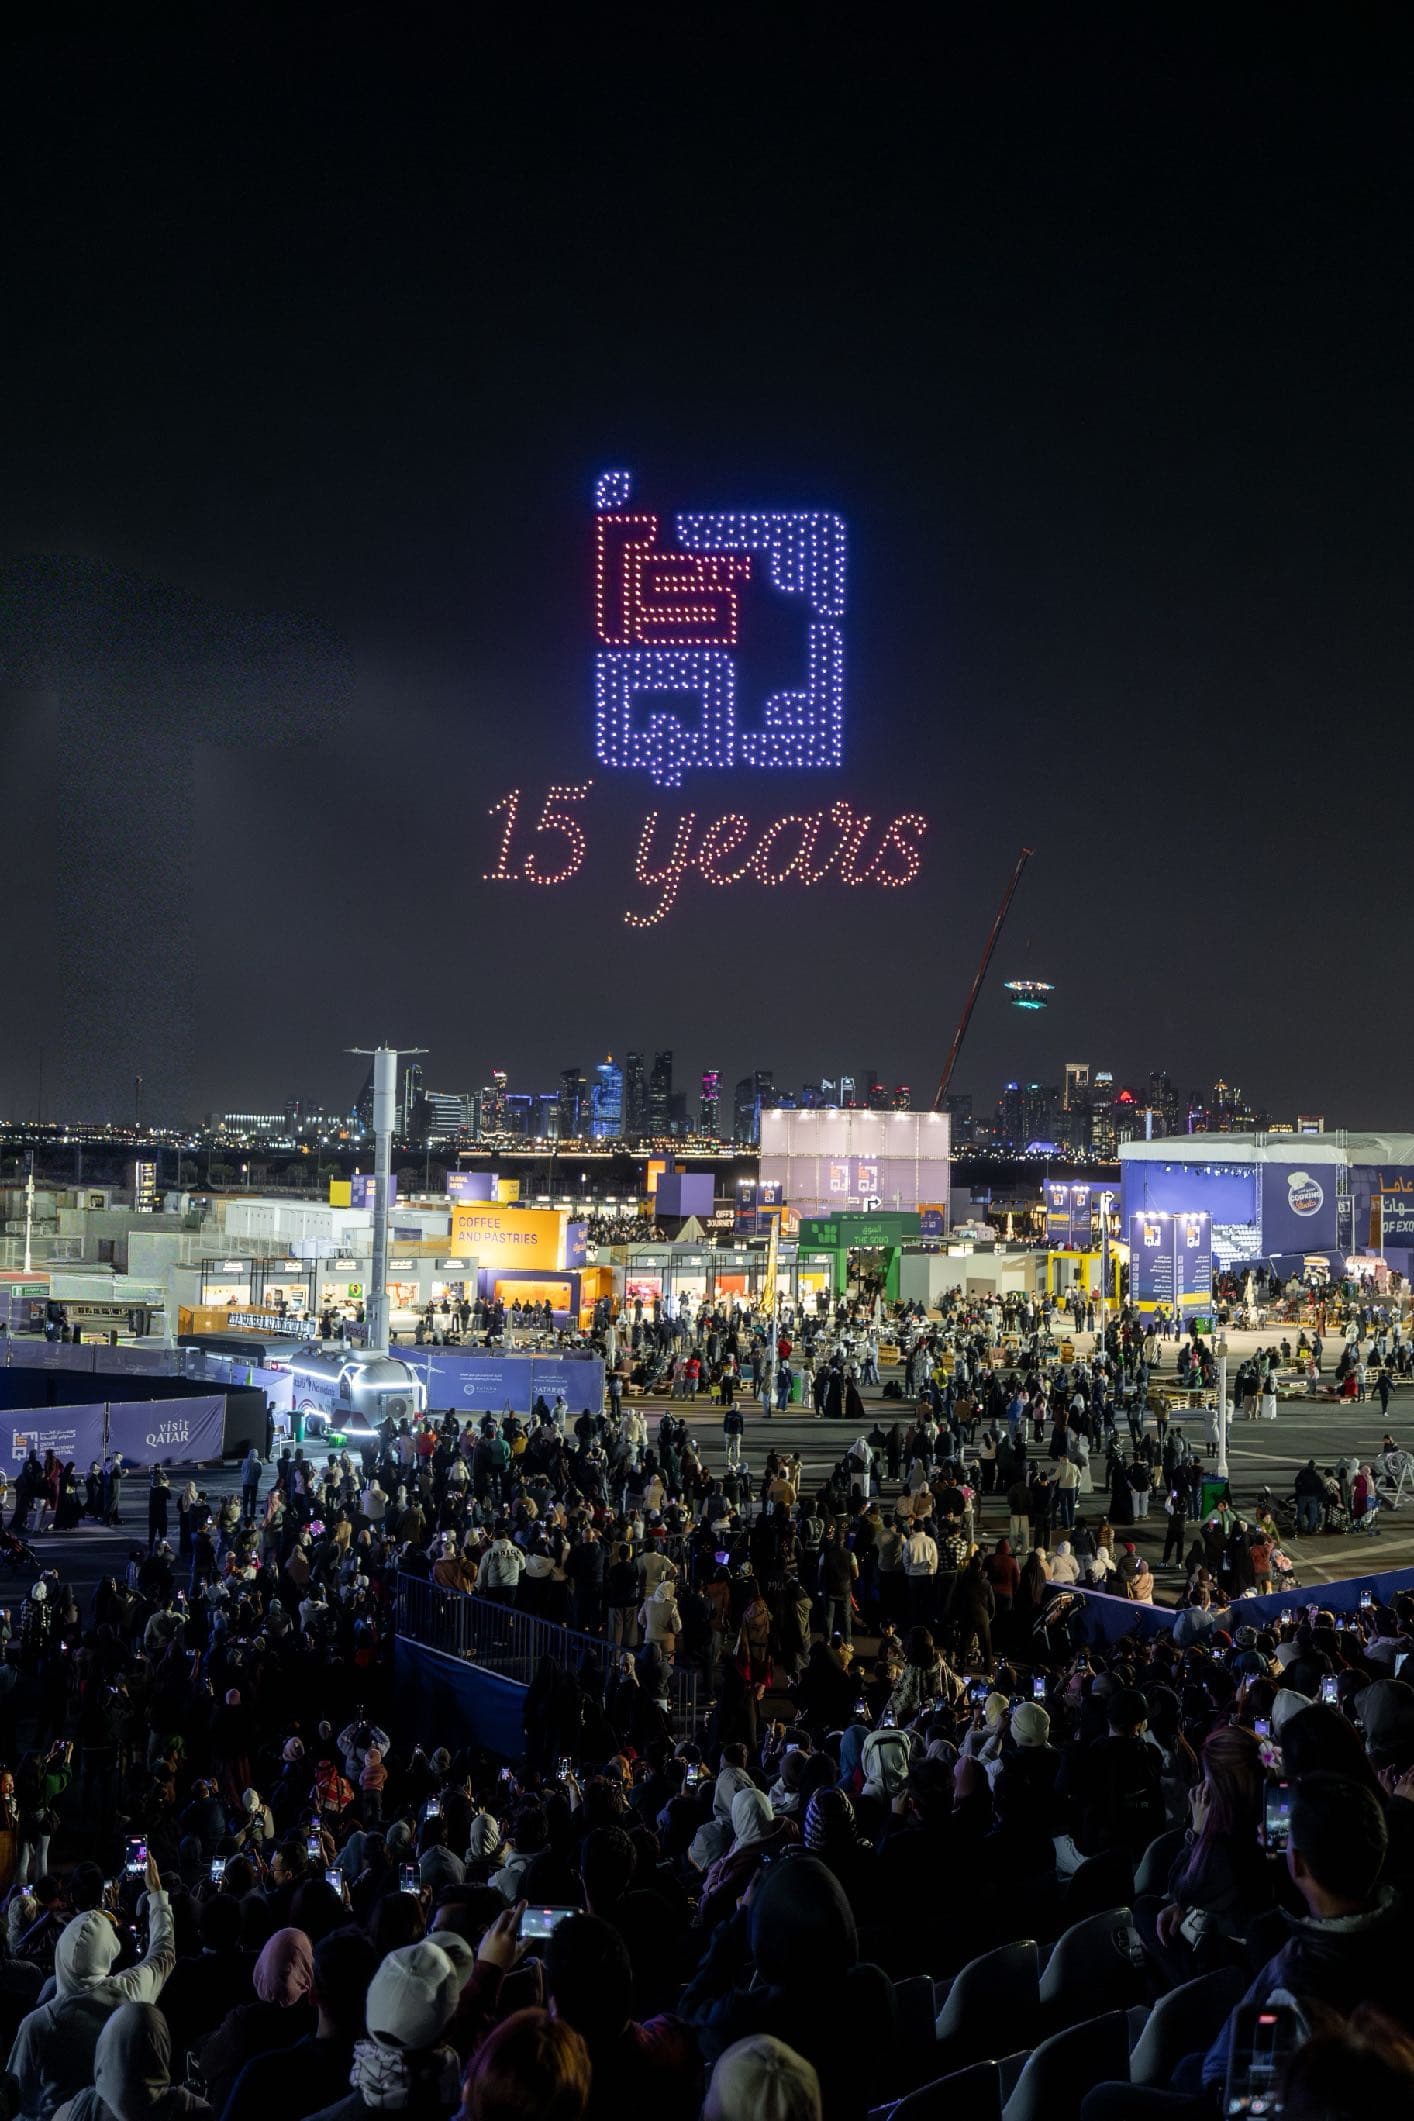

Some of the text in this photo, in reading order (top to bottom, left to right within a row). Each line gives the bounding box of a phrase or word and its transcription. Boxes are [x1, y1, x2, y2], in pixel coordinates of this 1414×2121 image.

[482, 779, 928, 928] 15 years
[458, 1216, 501, 1229] COFFEE
[458, 1231, 538, 1245] AND PASTRIES
[159, 1418, 189, 1433] visit
[146, 1431, 189, 1448] QATAR
